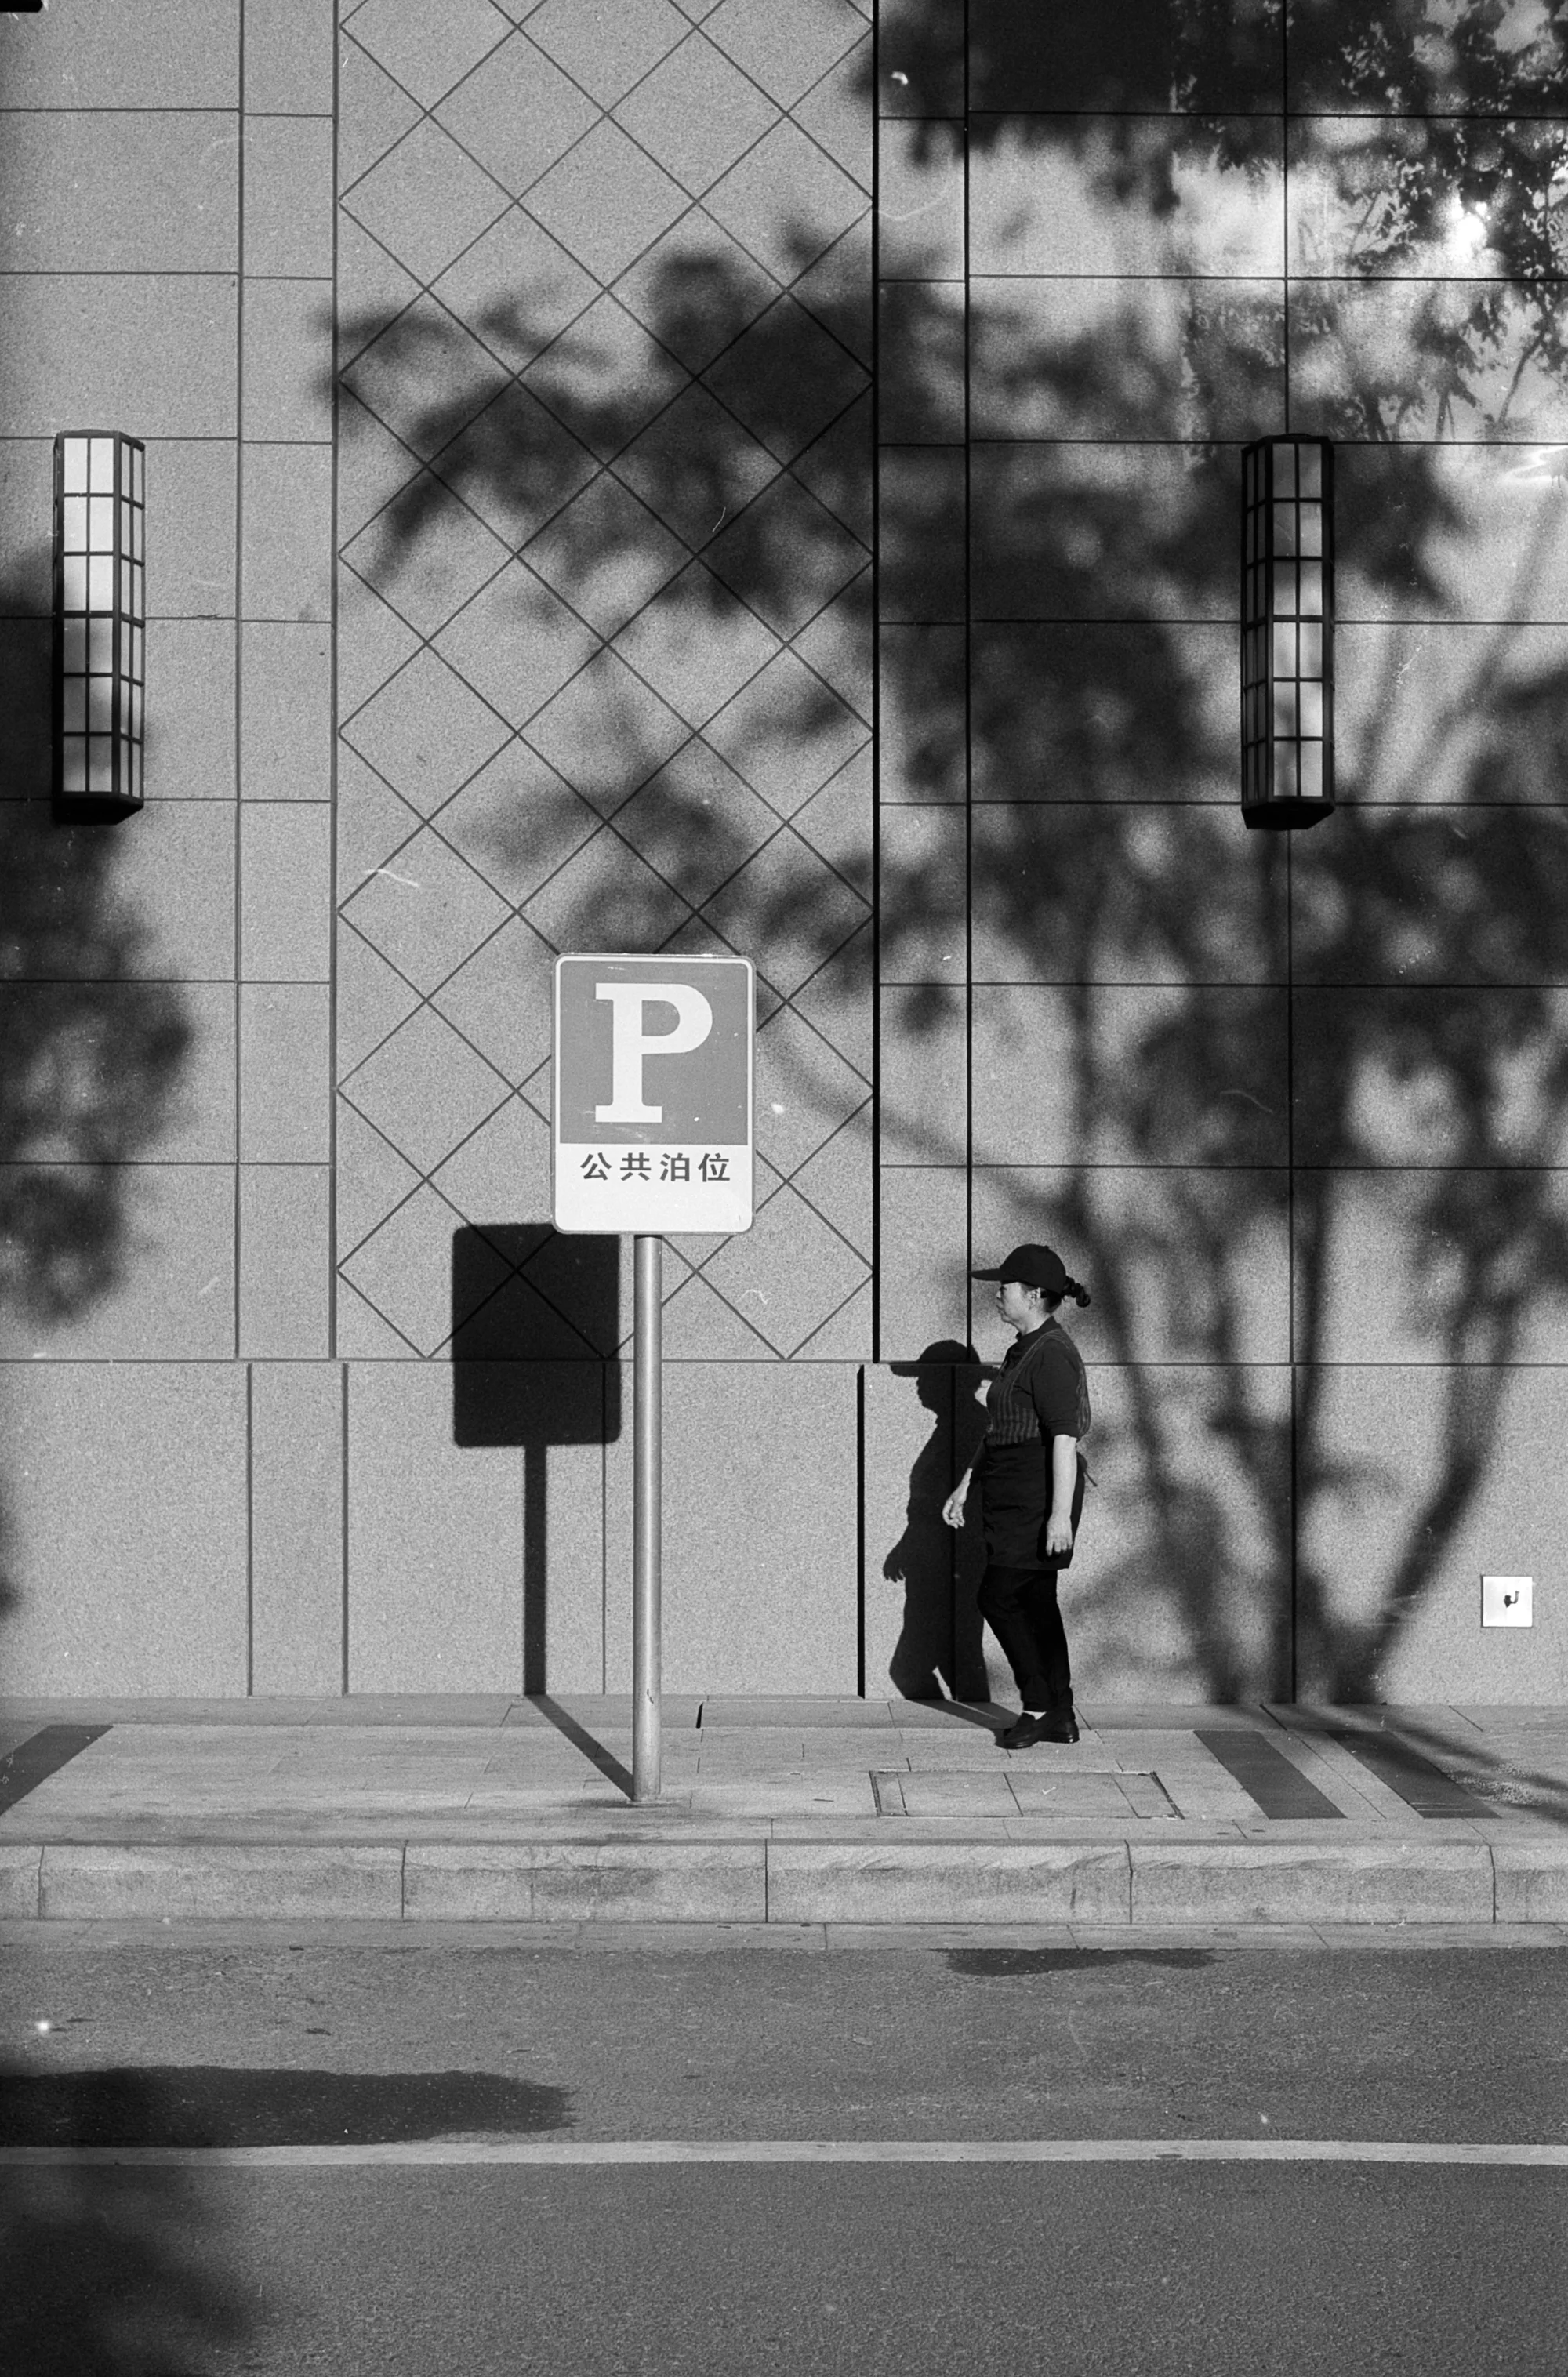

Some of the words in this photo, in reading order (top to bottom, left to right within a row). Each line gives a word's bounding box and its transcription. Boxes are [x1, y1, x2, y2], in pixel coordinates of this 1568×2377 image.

[595, 982, 713, 1123] P
[580, 1152, 731, 1182] 公共泊位
